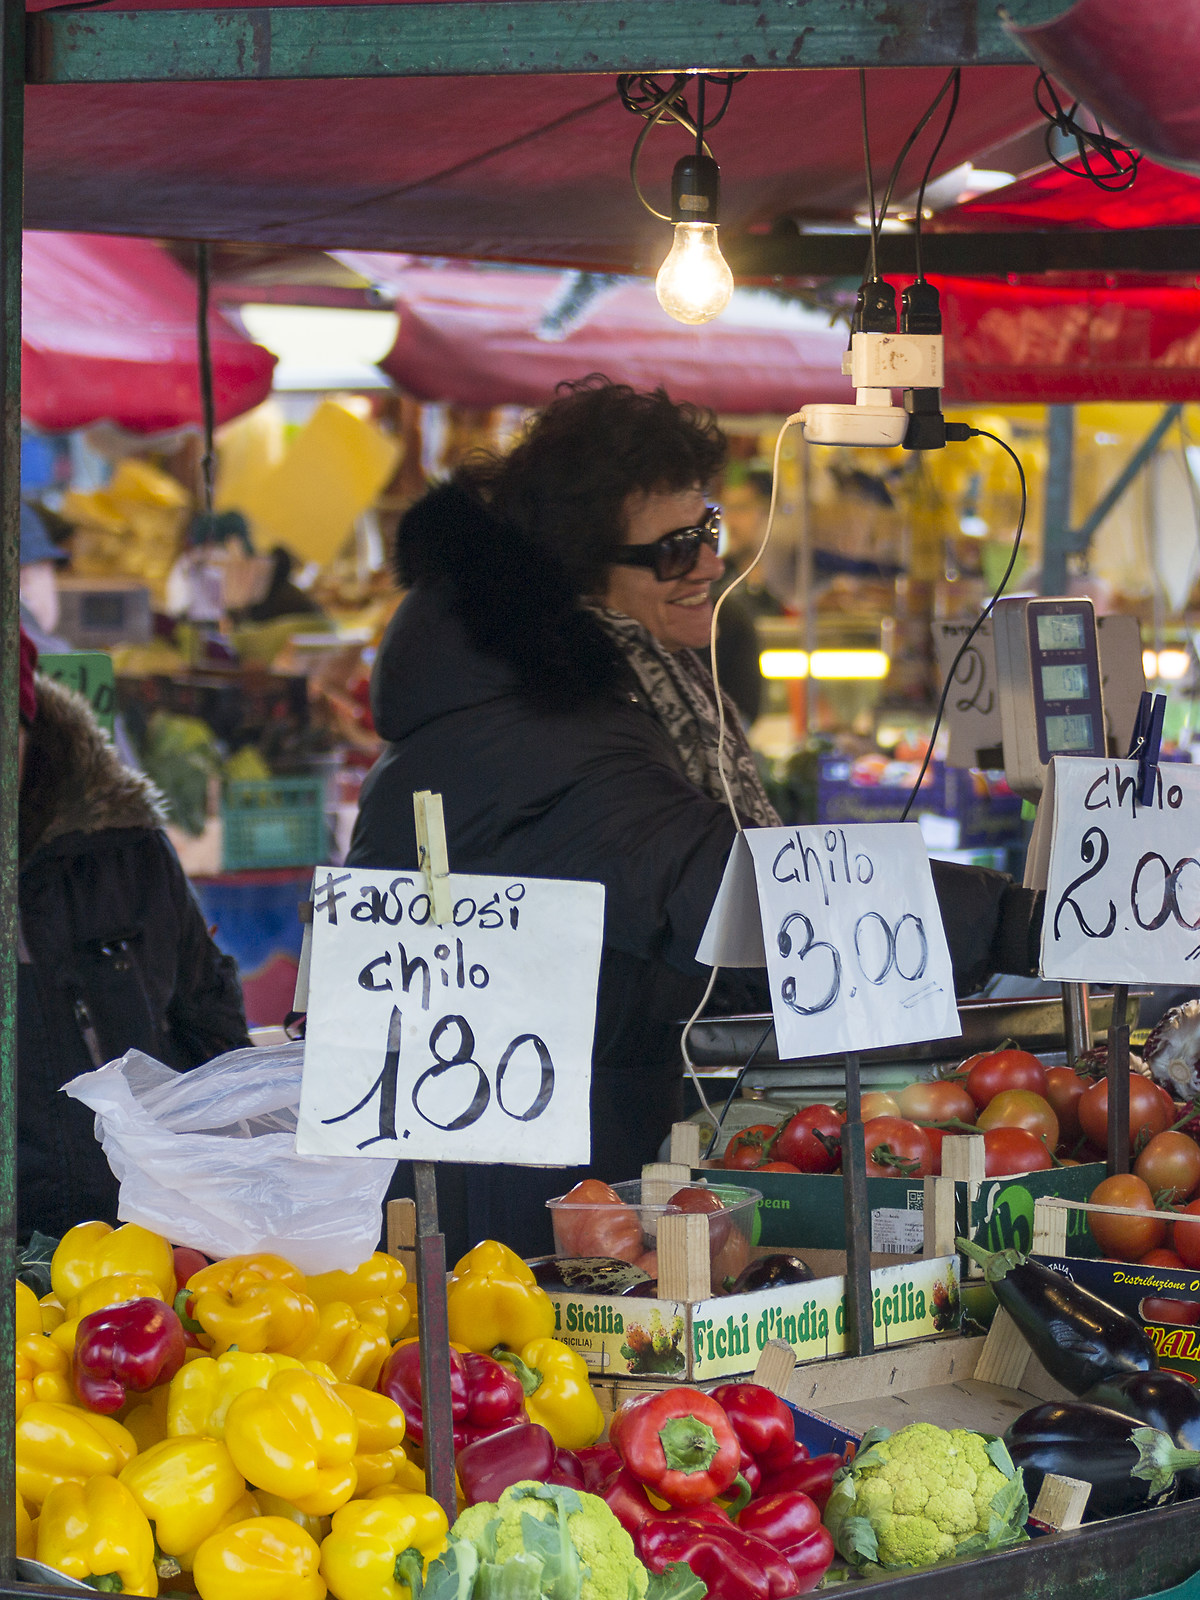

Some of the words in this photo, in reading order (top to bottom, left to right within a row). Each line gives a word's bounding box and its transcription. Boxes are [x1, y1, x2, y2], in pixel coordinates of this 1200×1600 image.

[952, 645, 993, 715] 2
[1084, 763, 1183, 819] chlo
[314, 872, 526, 930] Favoosi
[321, 1004, 555, 1150] 1.80
[1112, 1271, 1186, 1291] Distribuzione
[566, 1302, 624, 1335] Sicilia
[693, 1313, 750, 1362] Fichi
[756, 1299, 829, 1351] d'india
[835, 1294, 848, 1335] d
[871, 1281, 927, 1328] icilia
